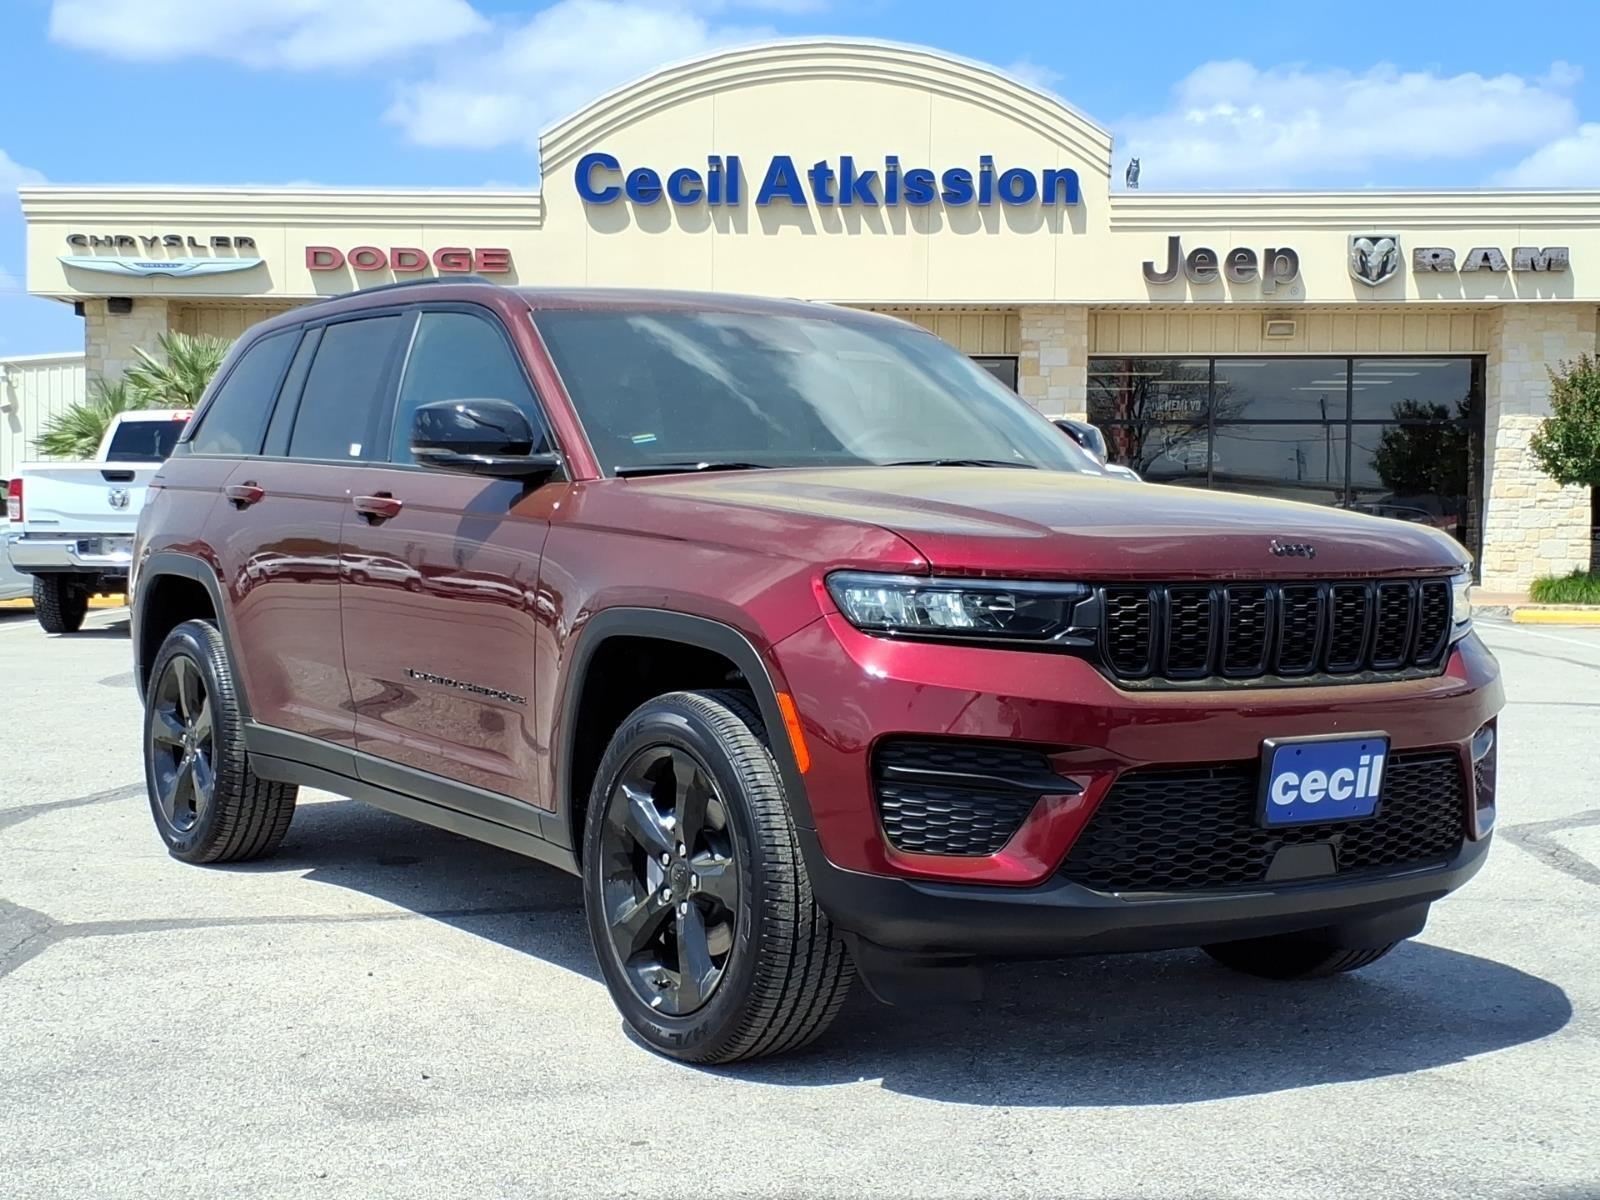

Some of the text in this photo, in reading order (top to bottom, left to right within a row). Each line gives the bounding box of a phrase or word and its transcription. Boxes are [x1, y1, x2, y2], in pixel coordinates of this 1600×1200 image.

[574, 152, 1080, 207] Cecil Atkission
[66, 233, 257, 249] CHRYSLER
[305, 245, 511, 274] DODGE
[1142, 235, 1300, 294] Jeep
[1412, 246, 1570, 273] RAM
[1268, 539, 1317, 560] Jeep
[1271, 754, 1384, 805] cecil
